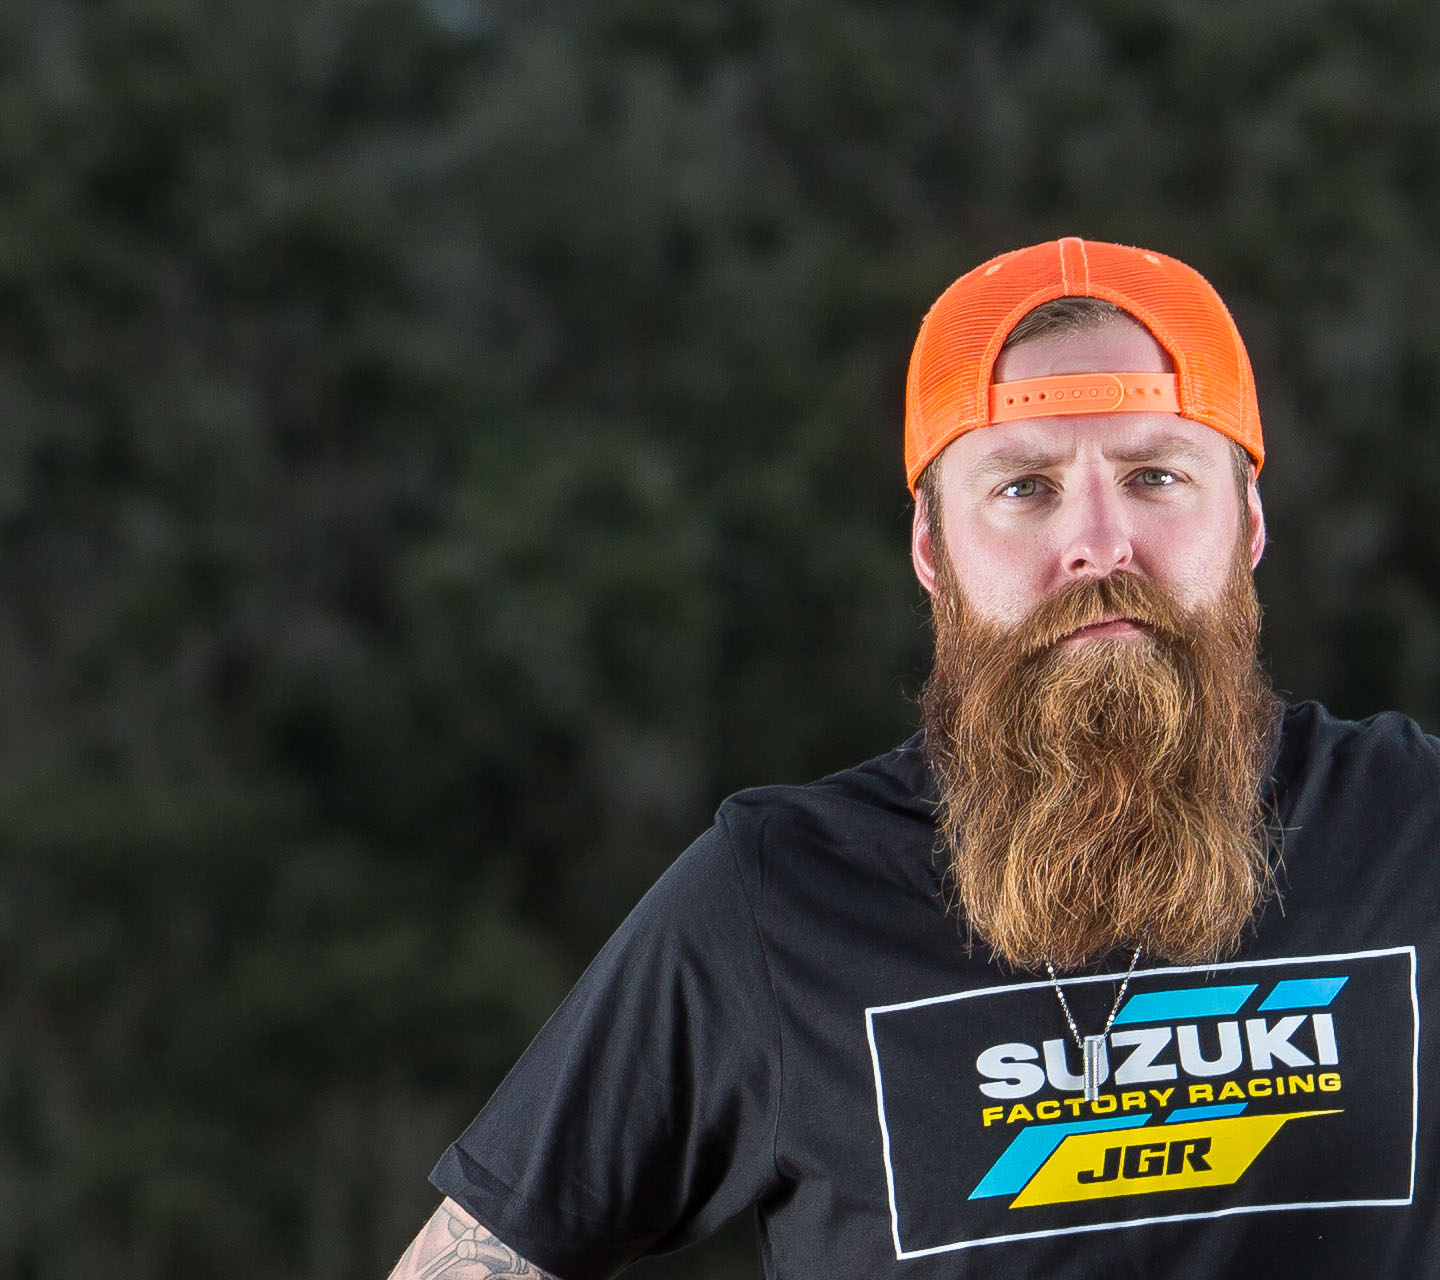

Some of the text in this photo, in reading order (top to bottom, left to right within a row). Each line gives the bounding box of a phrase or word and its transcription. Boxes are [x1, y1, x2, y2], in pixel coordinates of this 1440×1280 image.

[975, 1013, 1339, 1099] SUZUKI
[982, 1072, 1342, 1126] FACTORY RACING
[1077, 1137, 1212, 1185] JGR
